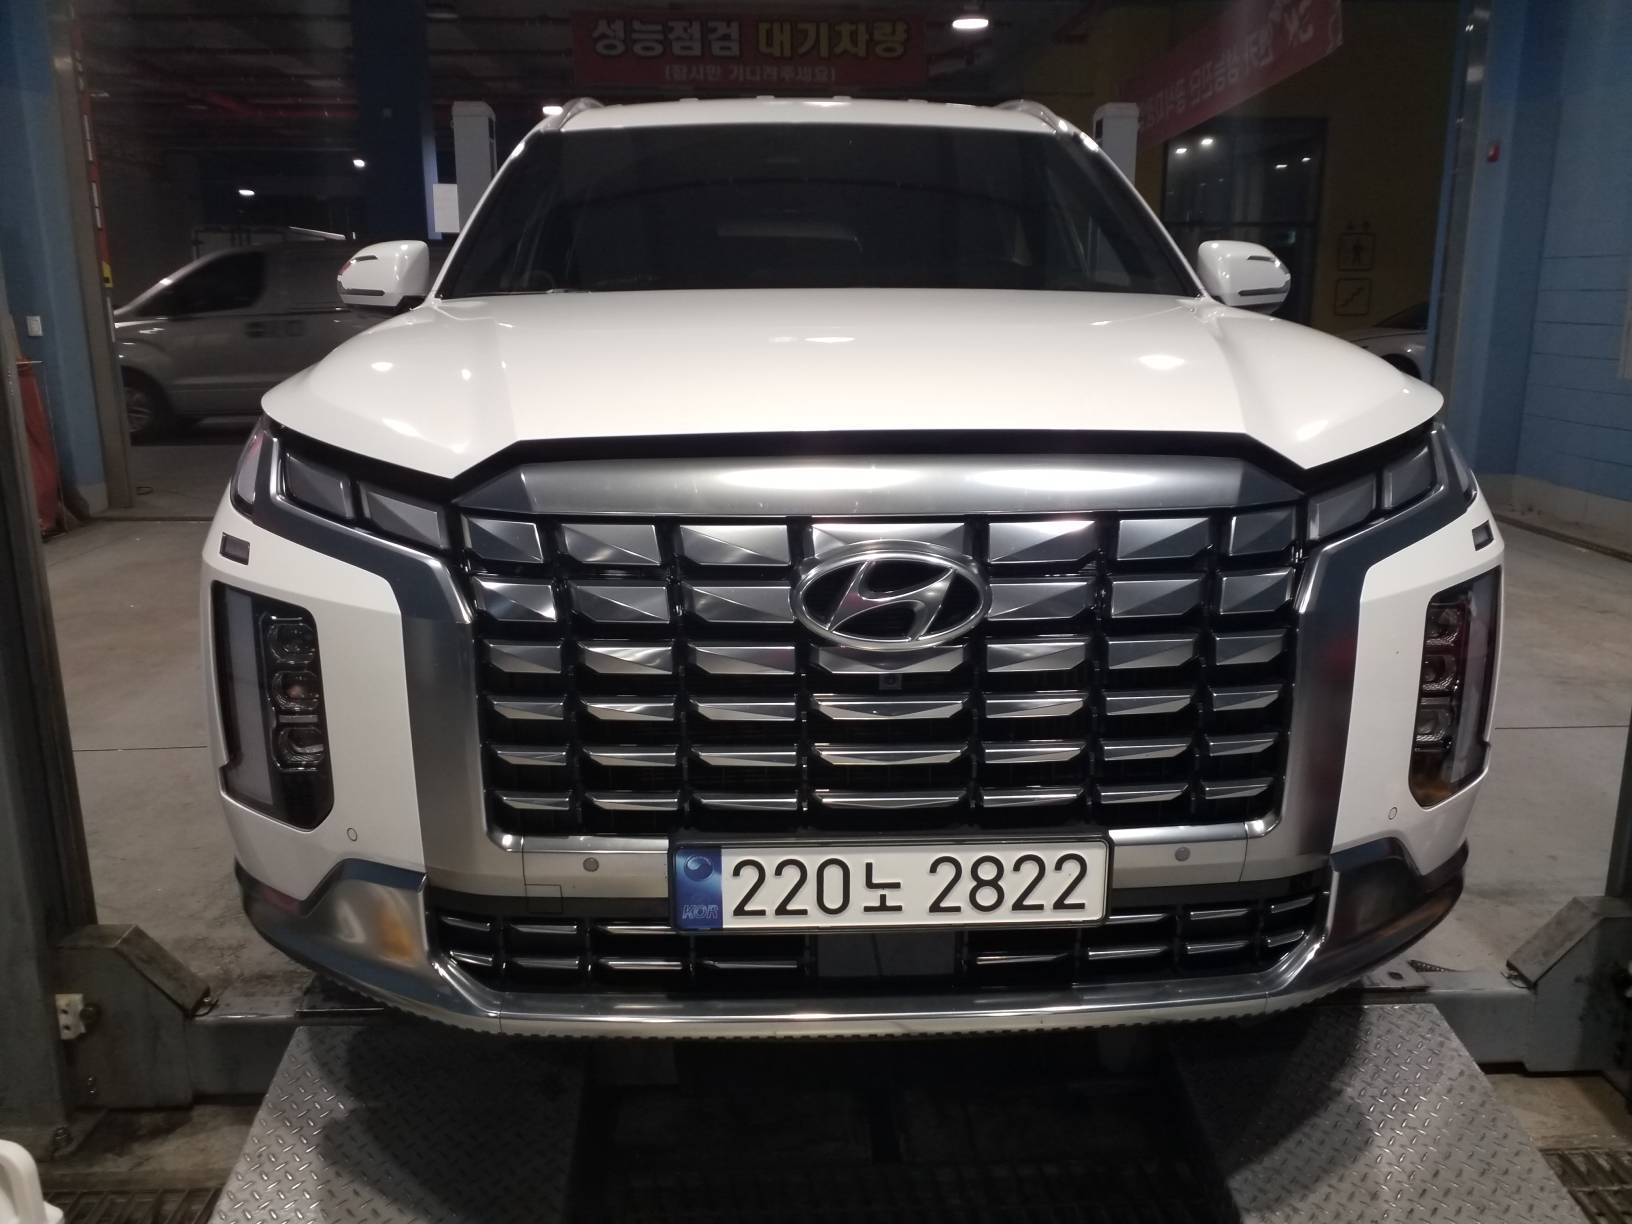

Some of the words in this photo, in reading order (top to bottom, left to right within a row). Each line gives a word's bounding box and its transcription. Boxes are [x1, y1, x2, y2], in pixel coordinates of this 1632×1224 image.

[592, 18, 742, 58] 성능점검
[758, 18, 909, 58] 대기차량
[731, 857, 903, 917] 220노
[928, 853, 1088, 913] 2822
[682, 904, 719, 920] KOR
